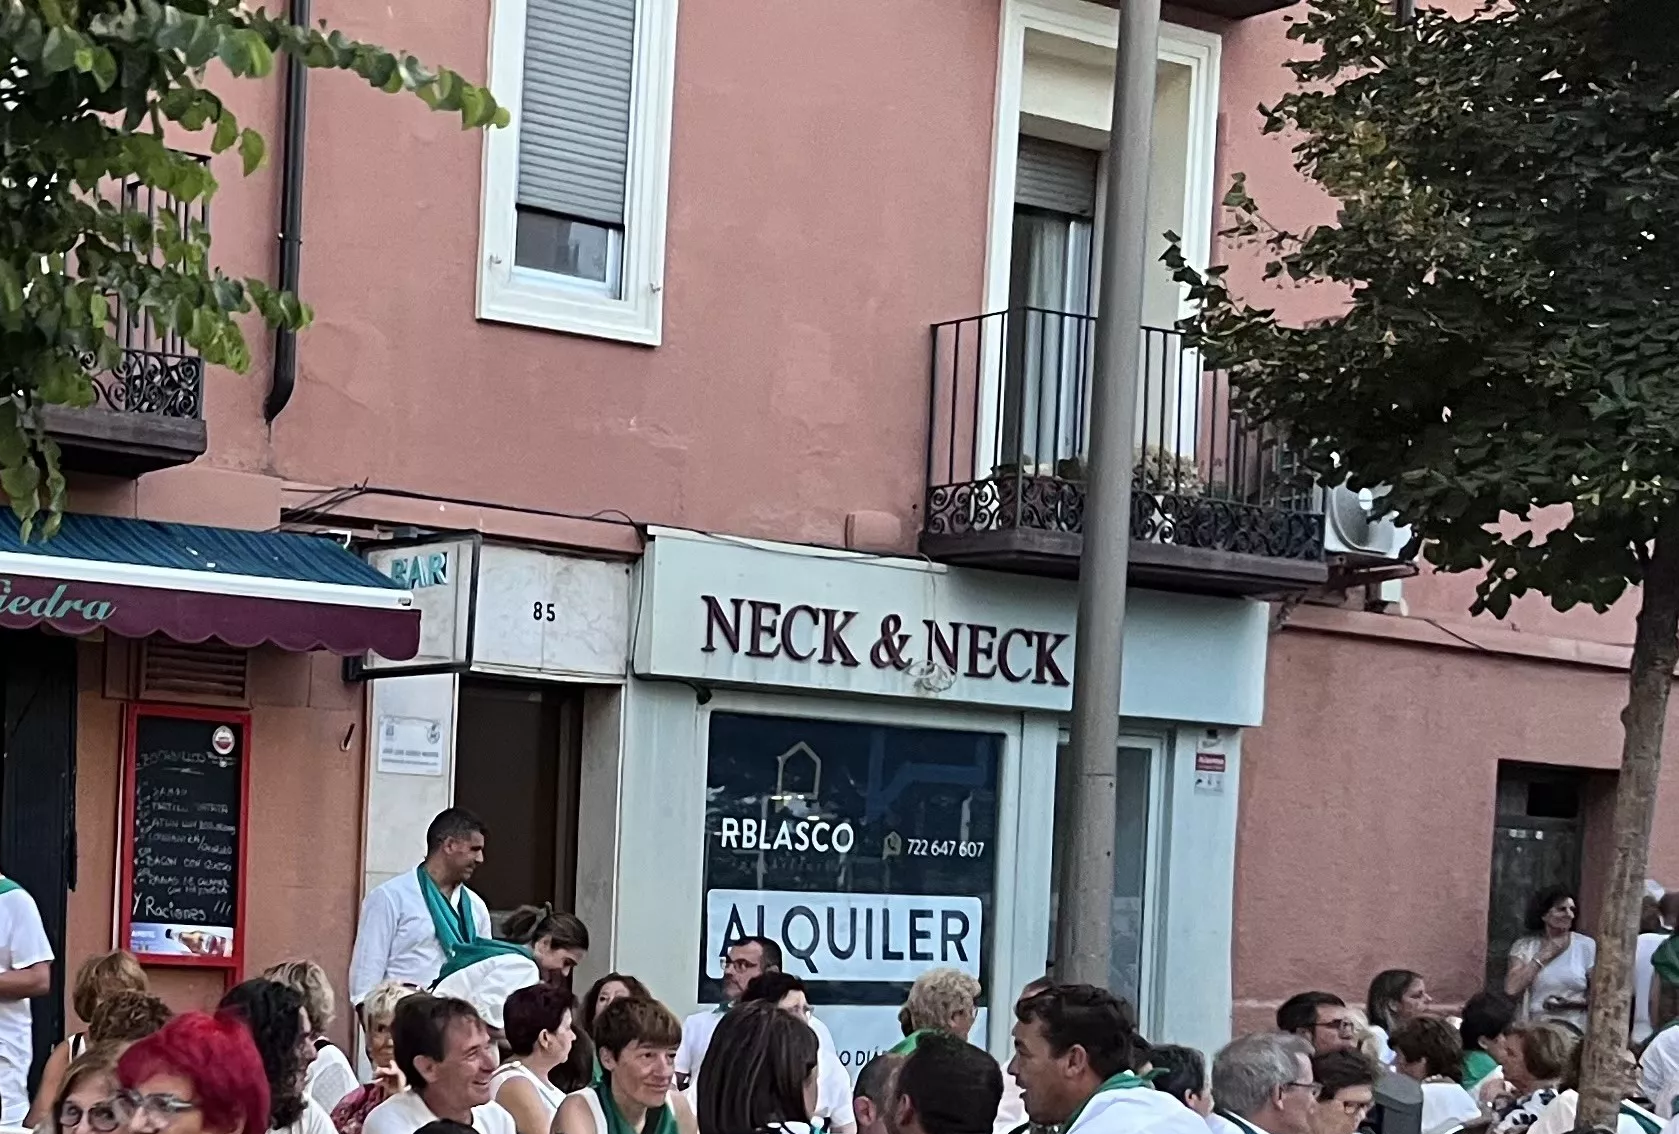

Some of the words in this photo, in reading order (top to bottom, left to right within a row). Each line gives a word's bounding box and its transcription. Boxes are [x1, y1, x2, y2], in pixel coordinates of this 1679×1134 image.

[391, 551, 448, 589] BAR
[533, 601, 556, 622] 85
[700, 594, 861, 667] NECK
[869, 613, 913, 671] &
[922, 618, 1071, 687] NECK
[721, 817, 854, 853] RBLASCO
[907, 838, 929, 856] 722
[931, 839, 956, 856] 647
[958, 841, 985, 858] 607
[145, 895, 207, 921] Raciones
